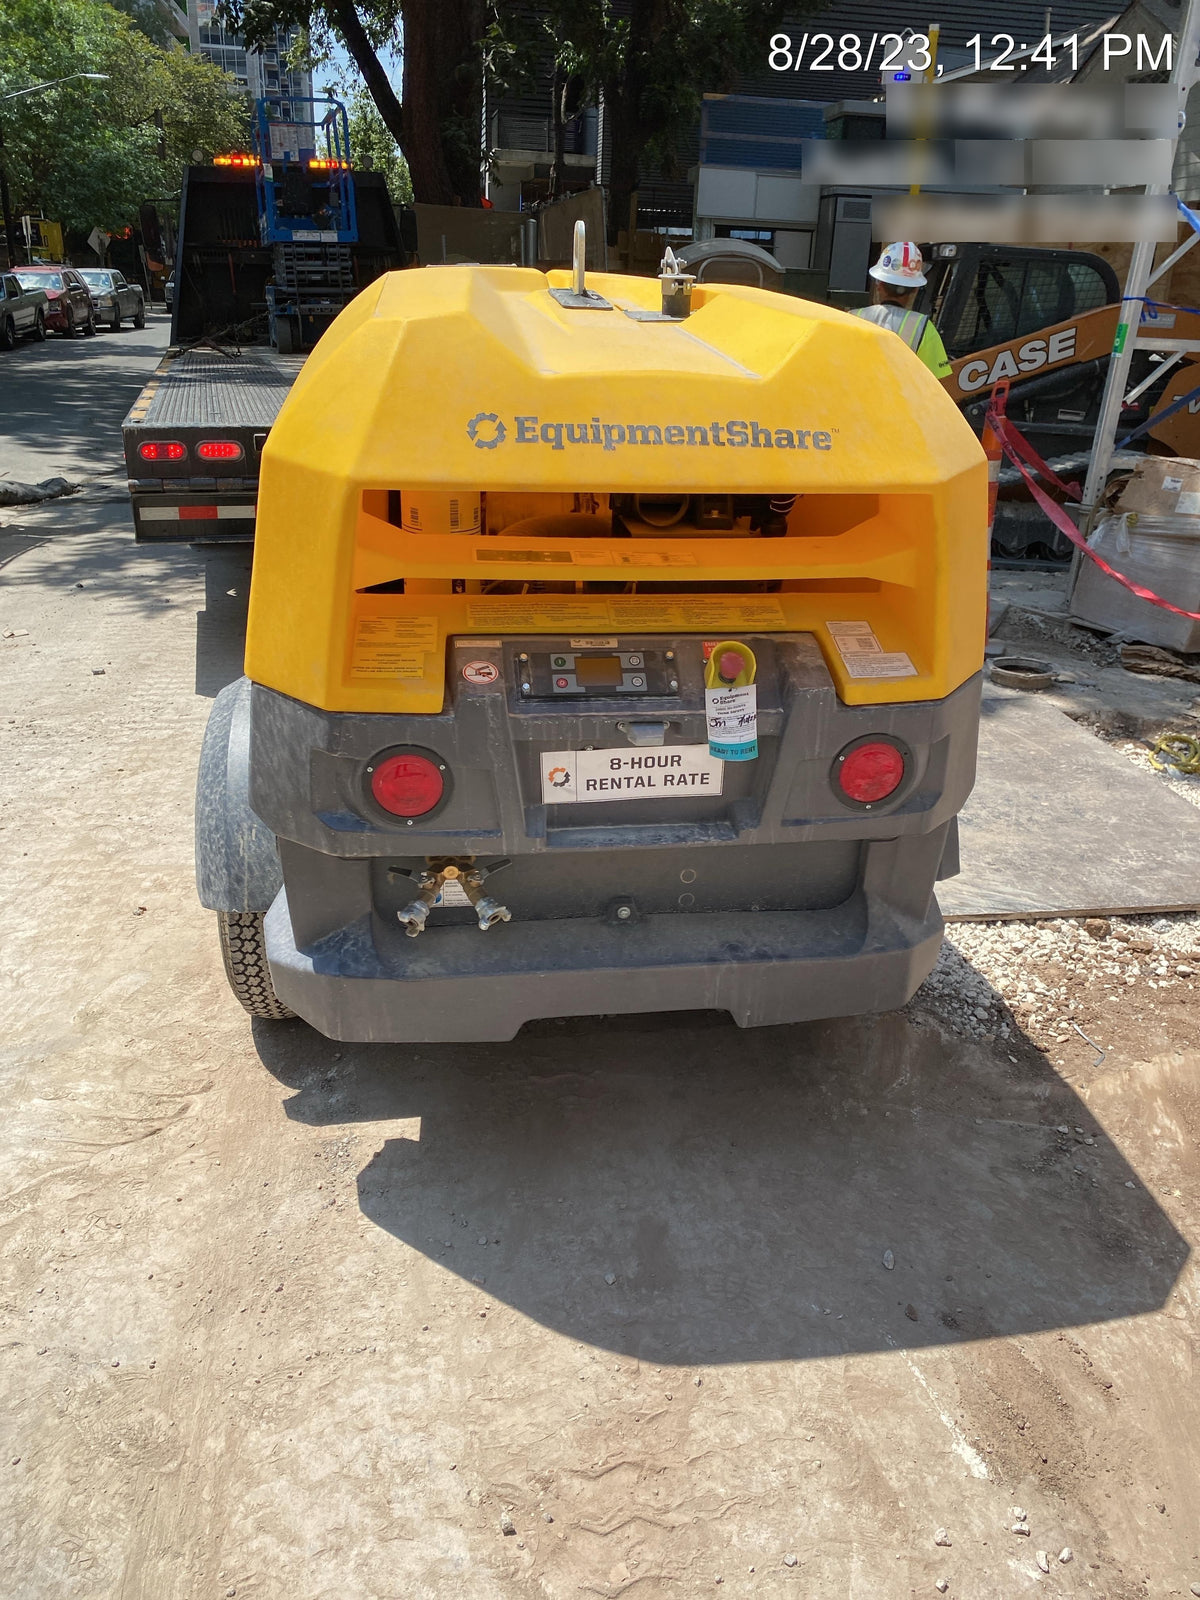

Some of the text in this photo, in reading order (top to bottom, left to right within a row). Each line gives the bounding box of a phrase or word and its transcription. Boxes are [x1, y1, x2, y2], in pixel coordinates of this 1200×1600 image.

[958, 327, 1077, 392] CASE
[514, 416, 833, 451] EquipmentShare
[740, 746, 755, 755] RENT
[609, 755, 682, 771] 8-HOUR
[586, 772, 711, 791] RENTAL RATE
